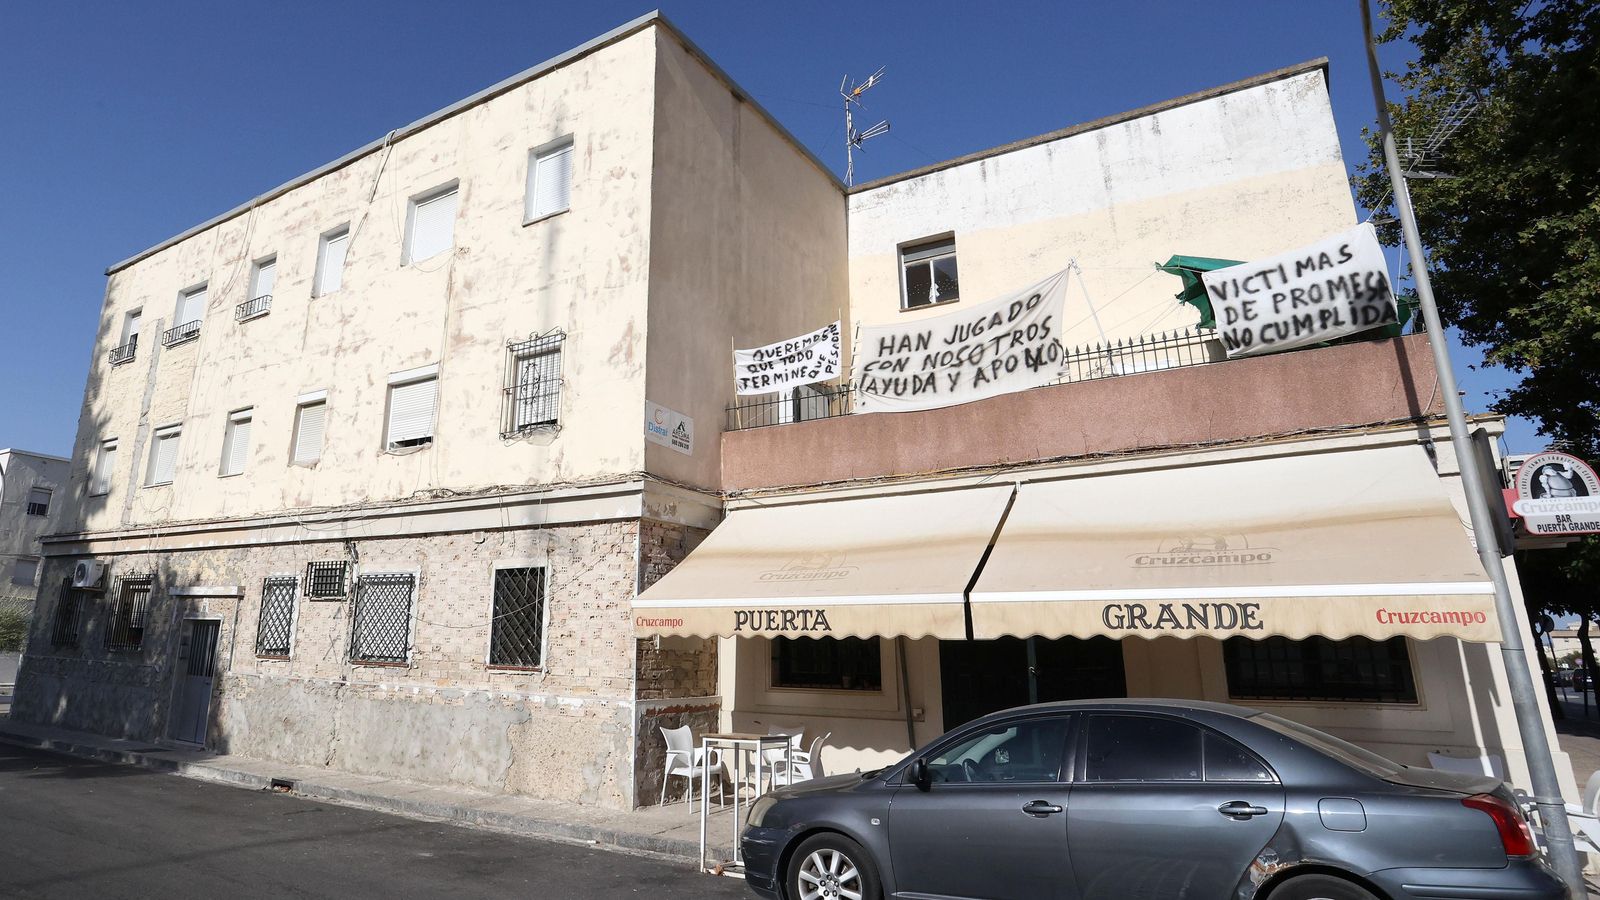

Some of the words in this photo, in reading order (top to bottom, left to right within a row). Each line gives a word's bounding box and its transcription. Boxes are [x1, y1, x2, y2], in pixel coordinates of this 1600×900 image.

[1209, 244, 1353, 301] VICTIMAS
[1223, 300, 1258, 326] DE
[1272, 270, 1394, 314] PROMESA
[878, 330, 932, 357] HAN
[944, 293, 1041, 345] JUGADO
[1223, 327, 1253, 351] NO
[1259, 301, 1398, 344] CUMPLIDA
[752, 328, 830, 361] QUEREMOS
[863, 356, 910, 373] CON
[921, 315, 1052, 371] NOSOTROS
[746, 360, 774, 374] QUE
[779, 349, 814, 366] TODO
[947, 371, 961, 392] Y
[1520, 500, 1600, 514] Cruzcamp
[1555, 514, 1573, 524] BAR
[1536, 523, 1568, 533] PUERTA
[1568, 521, 1600, 531] GRANDE
[1134, 552, 1272, 566] Cruzcampo
[636, 616, 684, 629] Cruzcampo
[734, 609, 832, 632] PUERTA
[1102, 603, 1264, 631] GRANDE
[1375, 607, 1487, 627] Cruzcampo
